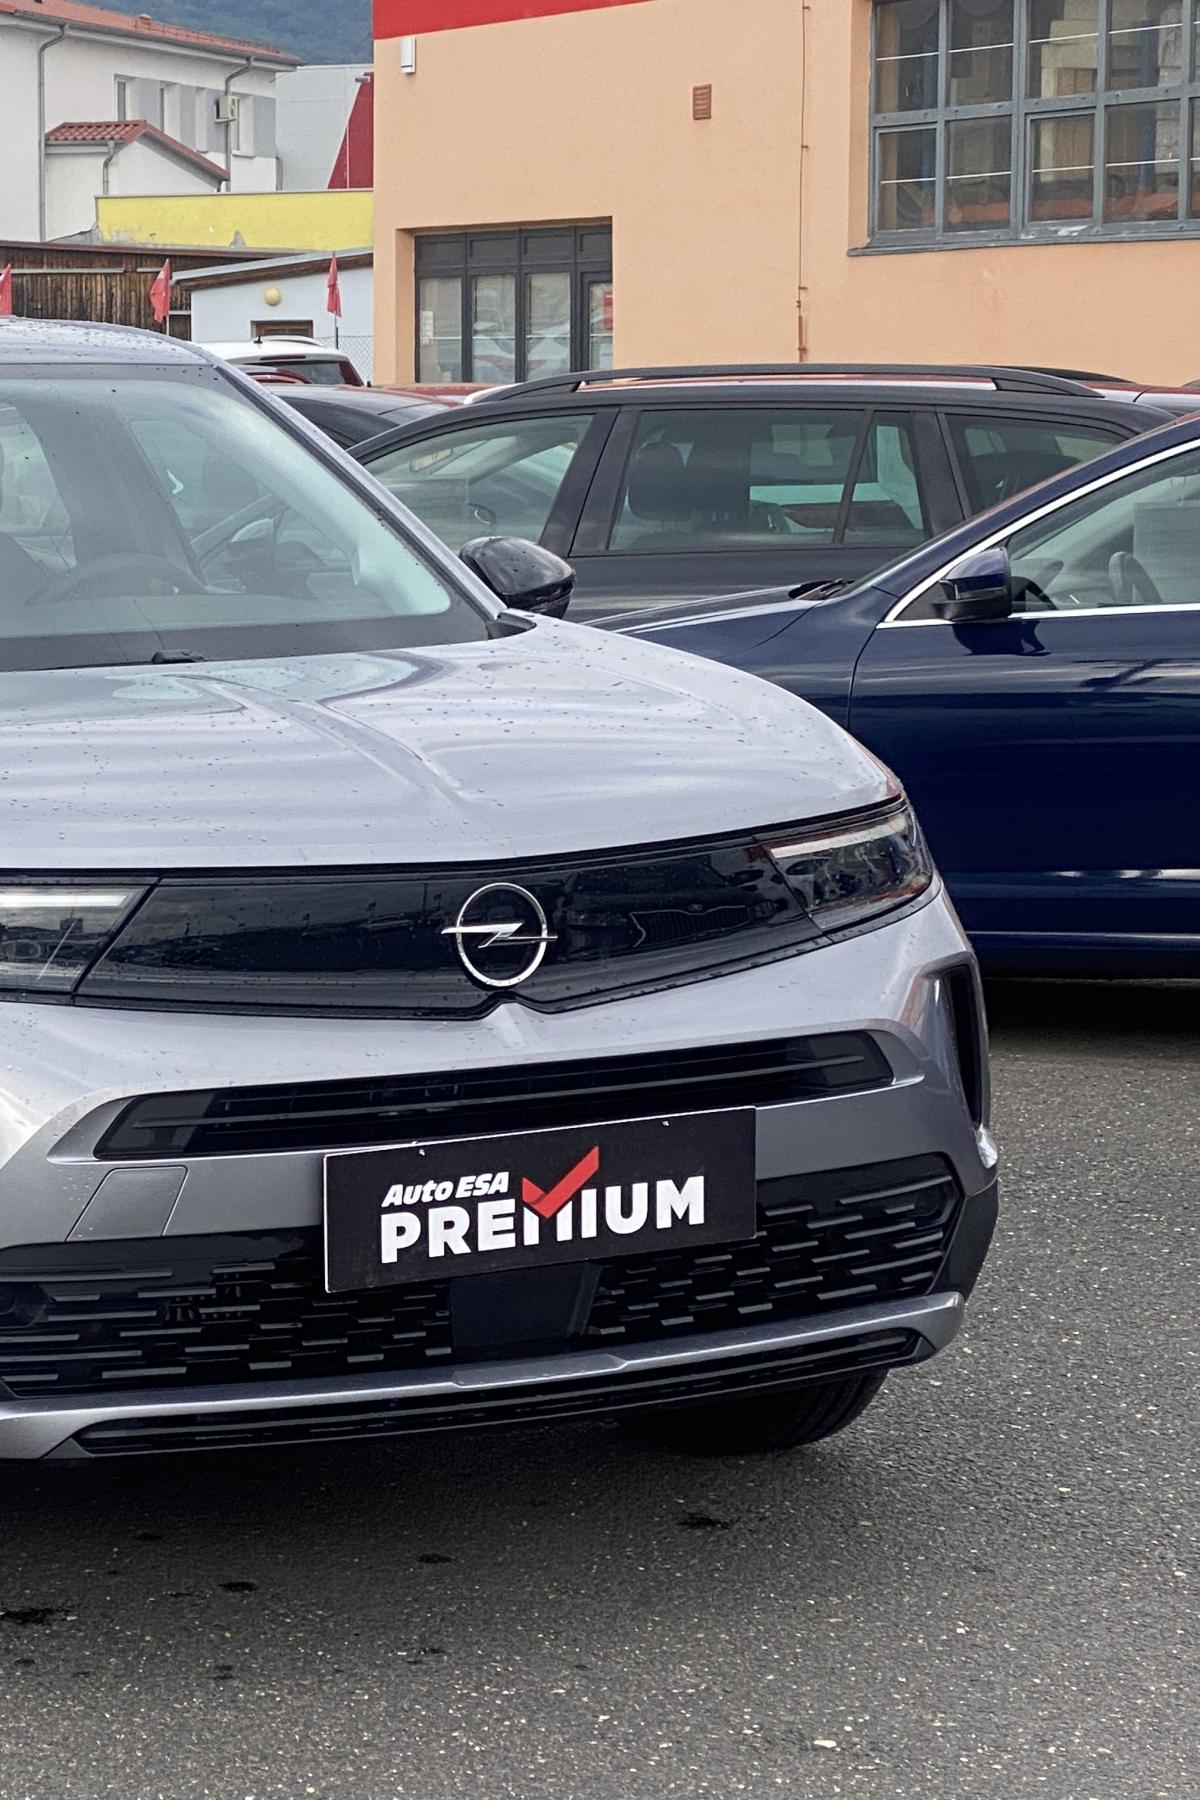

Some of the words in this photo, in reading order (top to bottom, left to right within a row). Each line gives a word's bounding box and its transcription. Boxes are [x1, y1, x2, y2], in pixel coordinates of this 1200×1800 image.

[380, 1175, 705, 1264] PREMIUM
[381, 1180, 453, 1207] Auto
[455, 1171, 509, 1199] ESA
